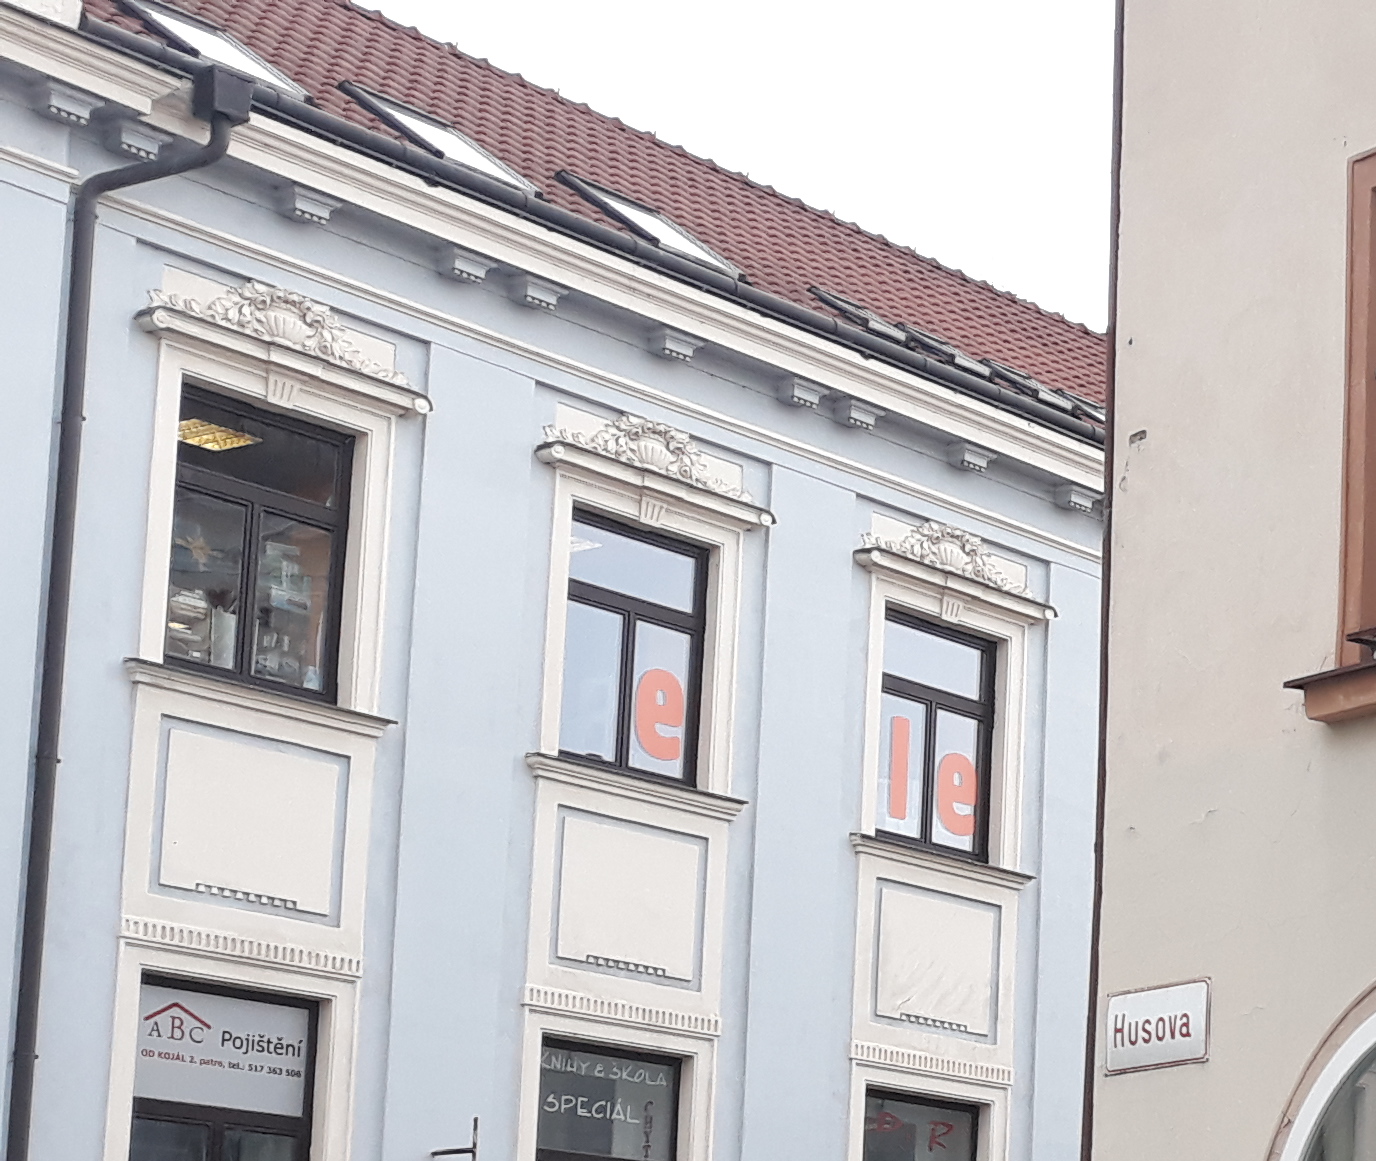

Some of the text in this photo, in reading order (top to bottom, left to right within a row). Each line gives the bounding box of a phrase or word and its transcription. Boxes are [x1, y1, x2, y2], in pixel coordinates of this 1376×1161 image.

[147, 1015, 304, 1058] ABC Pojištění
[1113, 1012, 1192, 1048] Husova
[247, 1063, 264, 1073] 517
[608, 1061, 668, 1086] ŠKOLA
[543, 1093, 640, 1124] SPECIÁL
